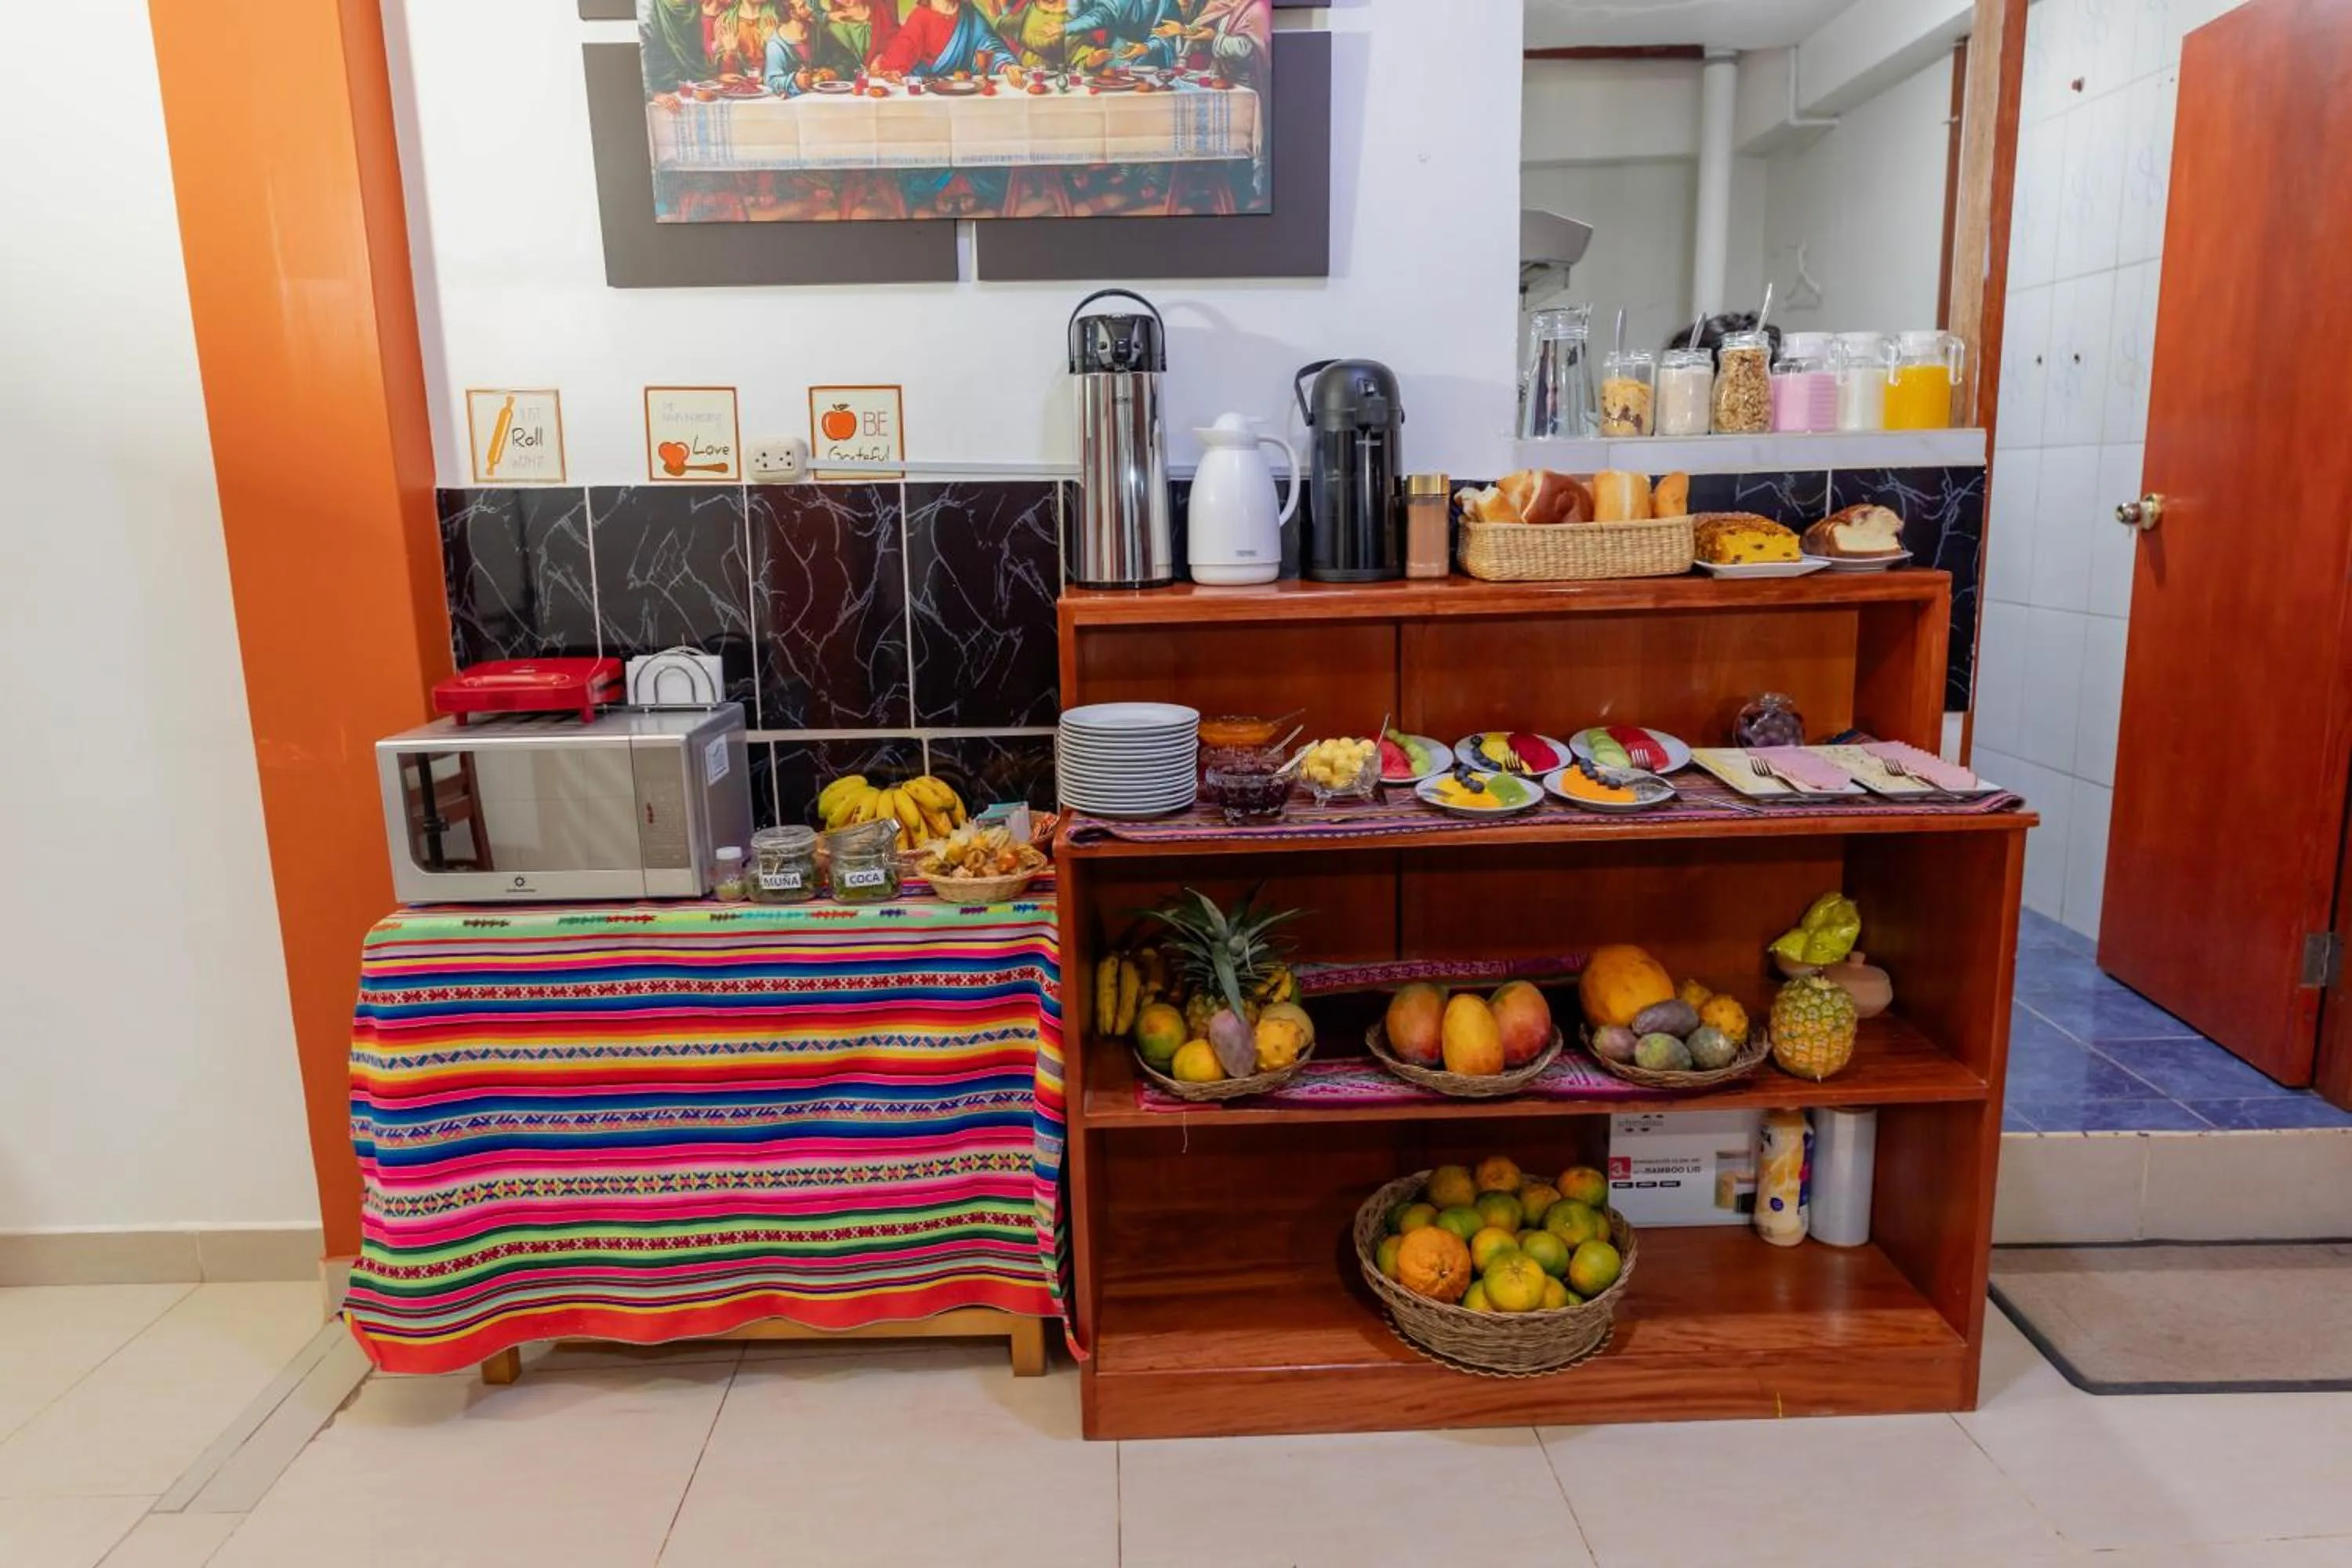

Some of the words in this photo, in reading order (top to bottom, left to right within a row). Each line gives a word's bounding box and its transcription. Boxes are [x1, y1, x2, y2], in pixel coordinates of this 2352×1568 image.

[862, 411, 888, 437] BE
[511, 426, 544, 448] Roll
[692, 434, 730, 456] Love
[849, 873, 880, 885] COCA
